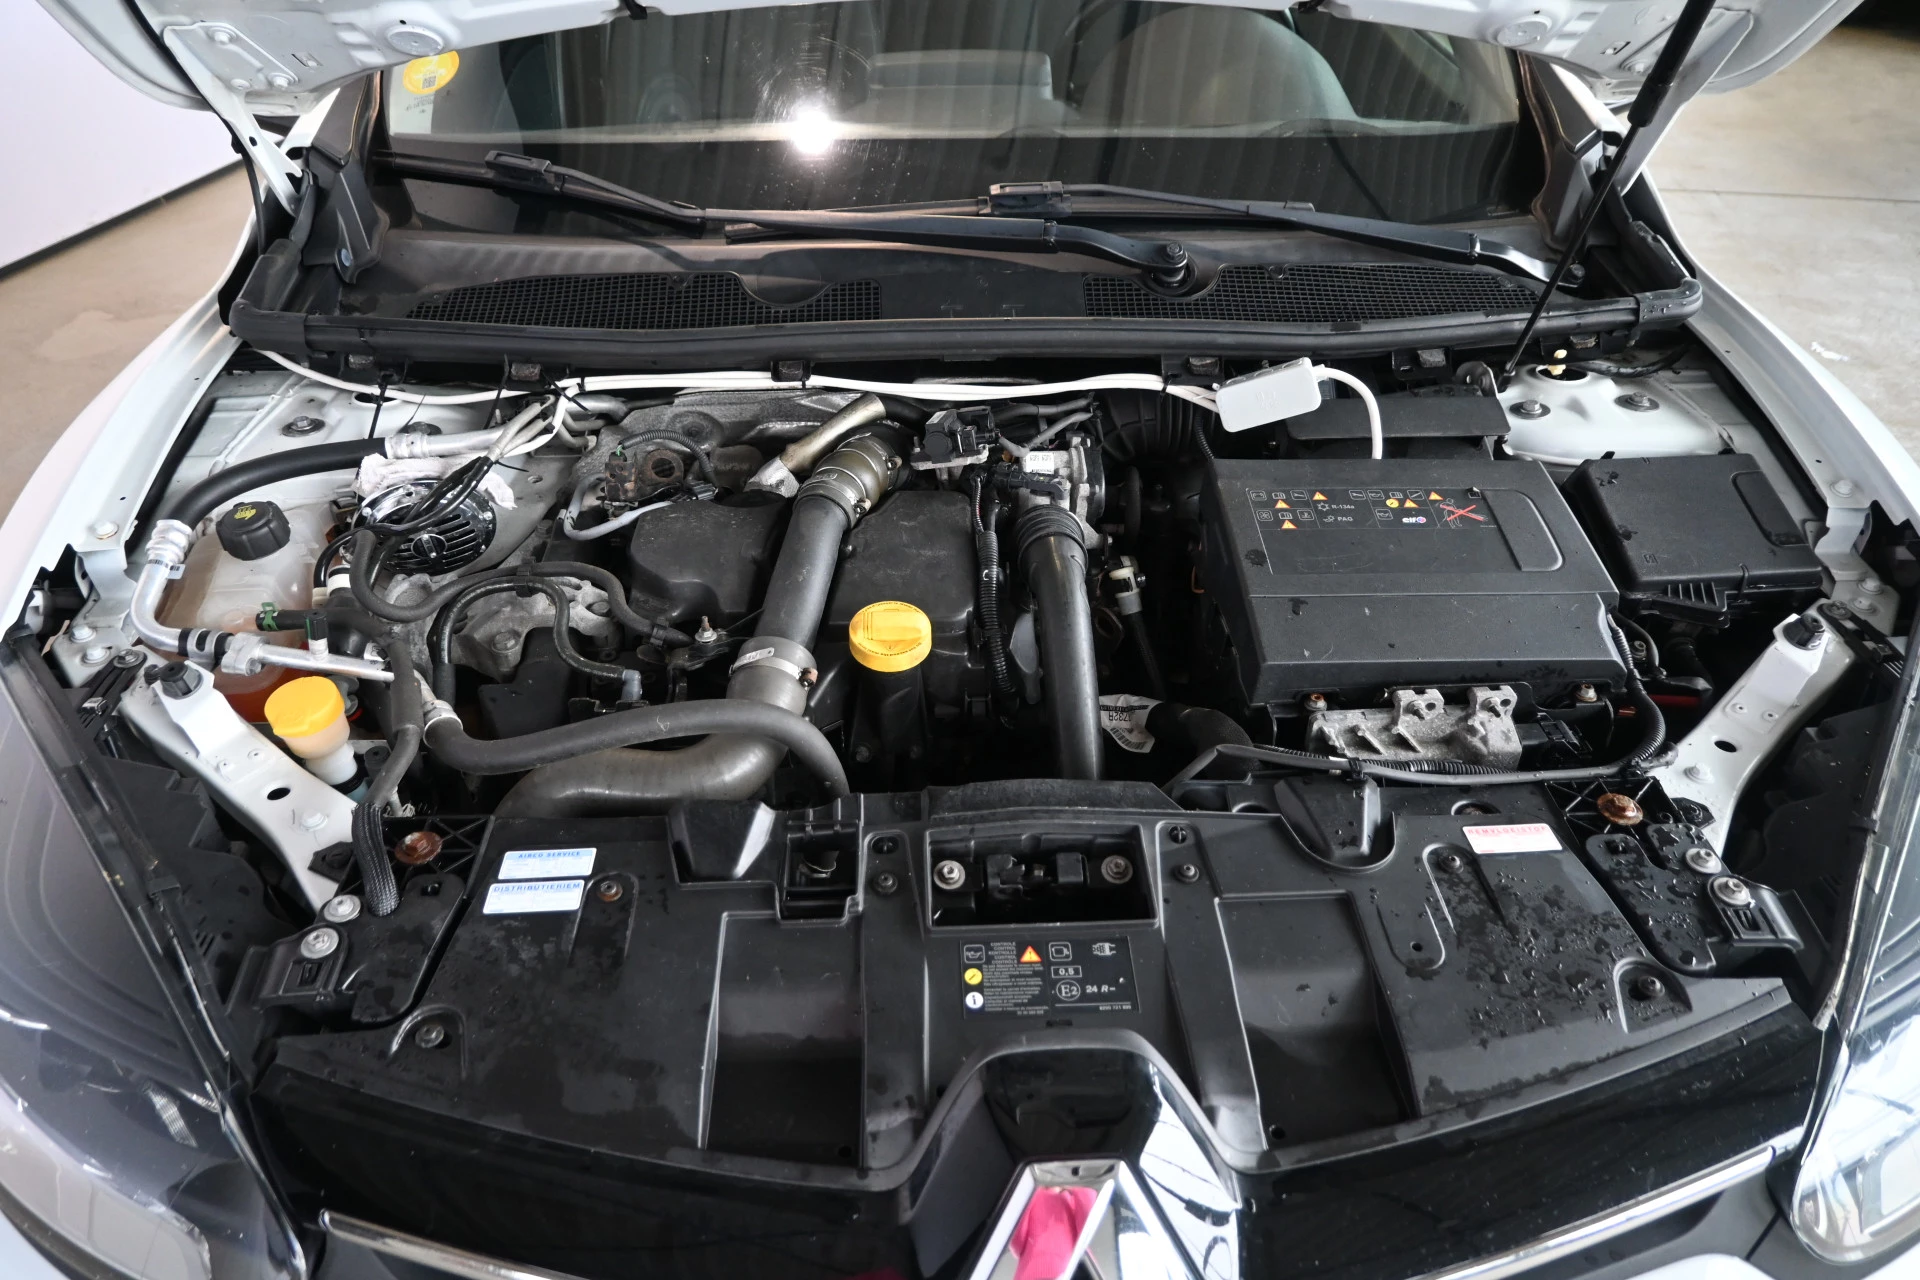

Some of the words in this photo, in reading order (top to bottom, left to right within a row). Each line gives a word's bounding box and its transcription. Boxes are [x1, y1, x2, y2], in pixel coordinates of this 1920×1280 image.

[493, 883, 580, 892] DISTRIBUTIERIEM
[1059, 967, 1074, 976] 0,5
[1061, 984, 1078, 997] E2
[1086, 985, 1098, 993] 24
